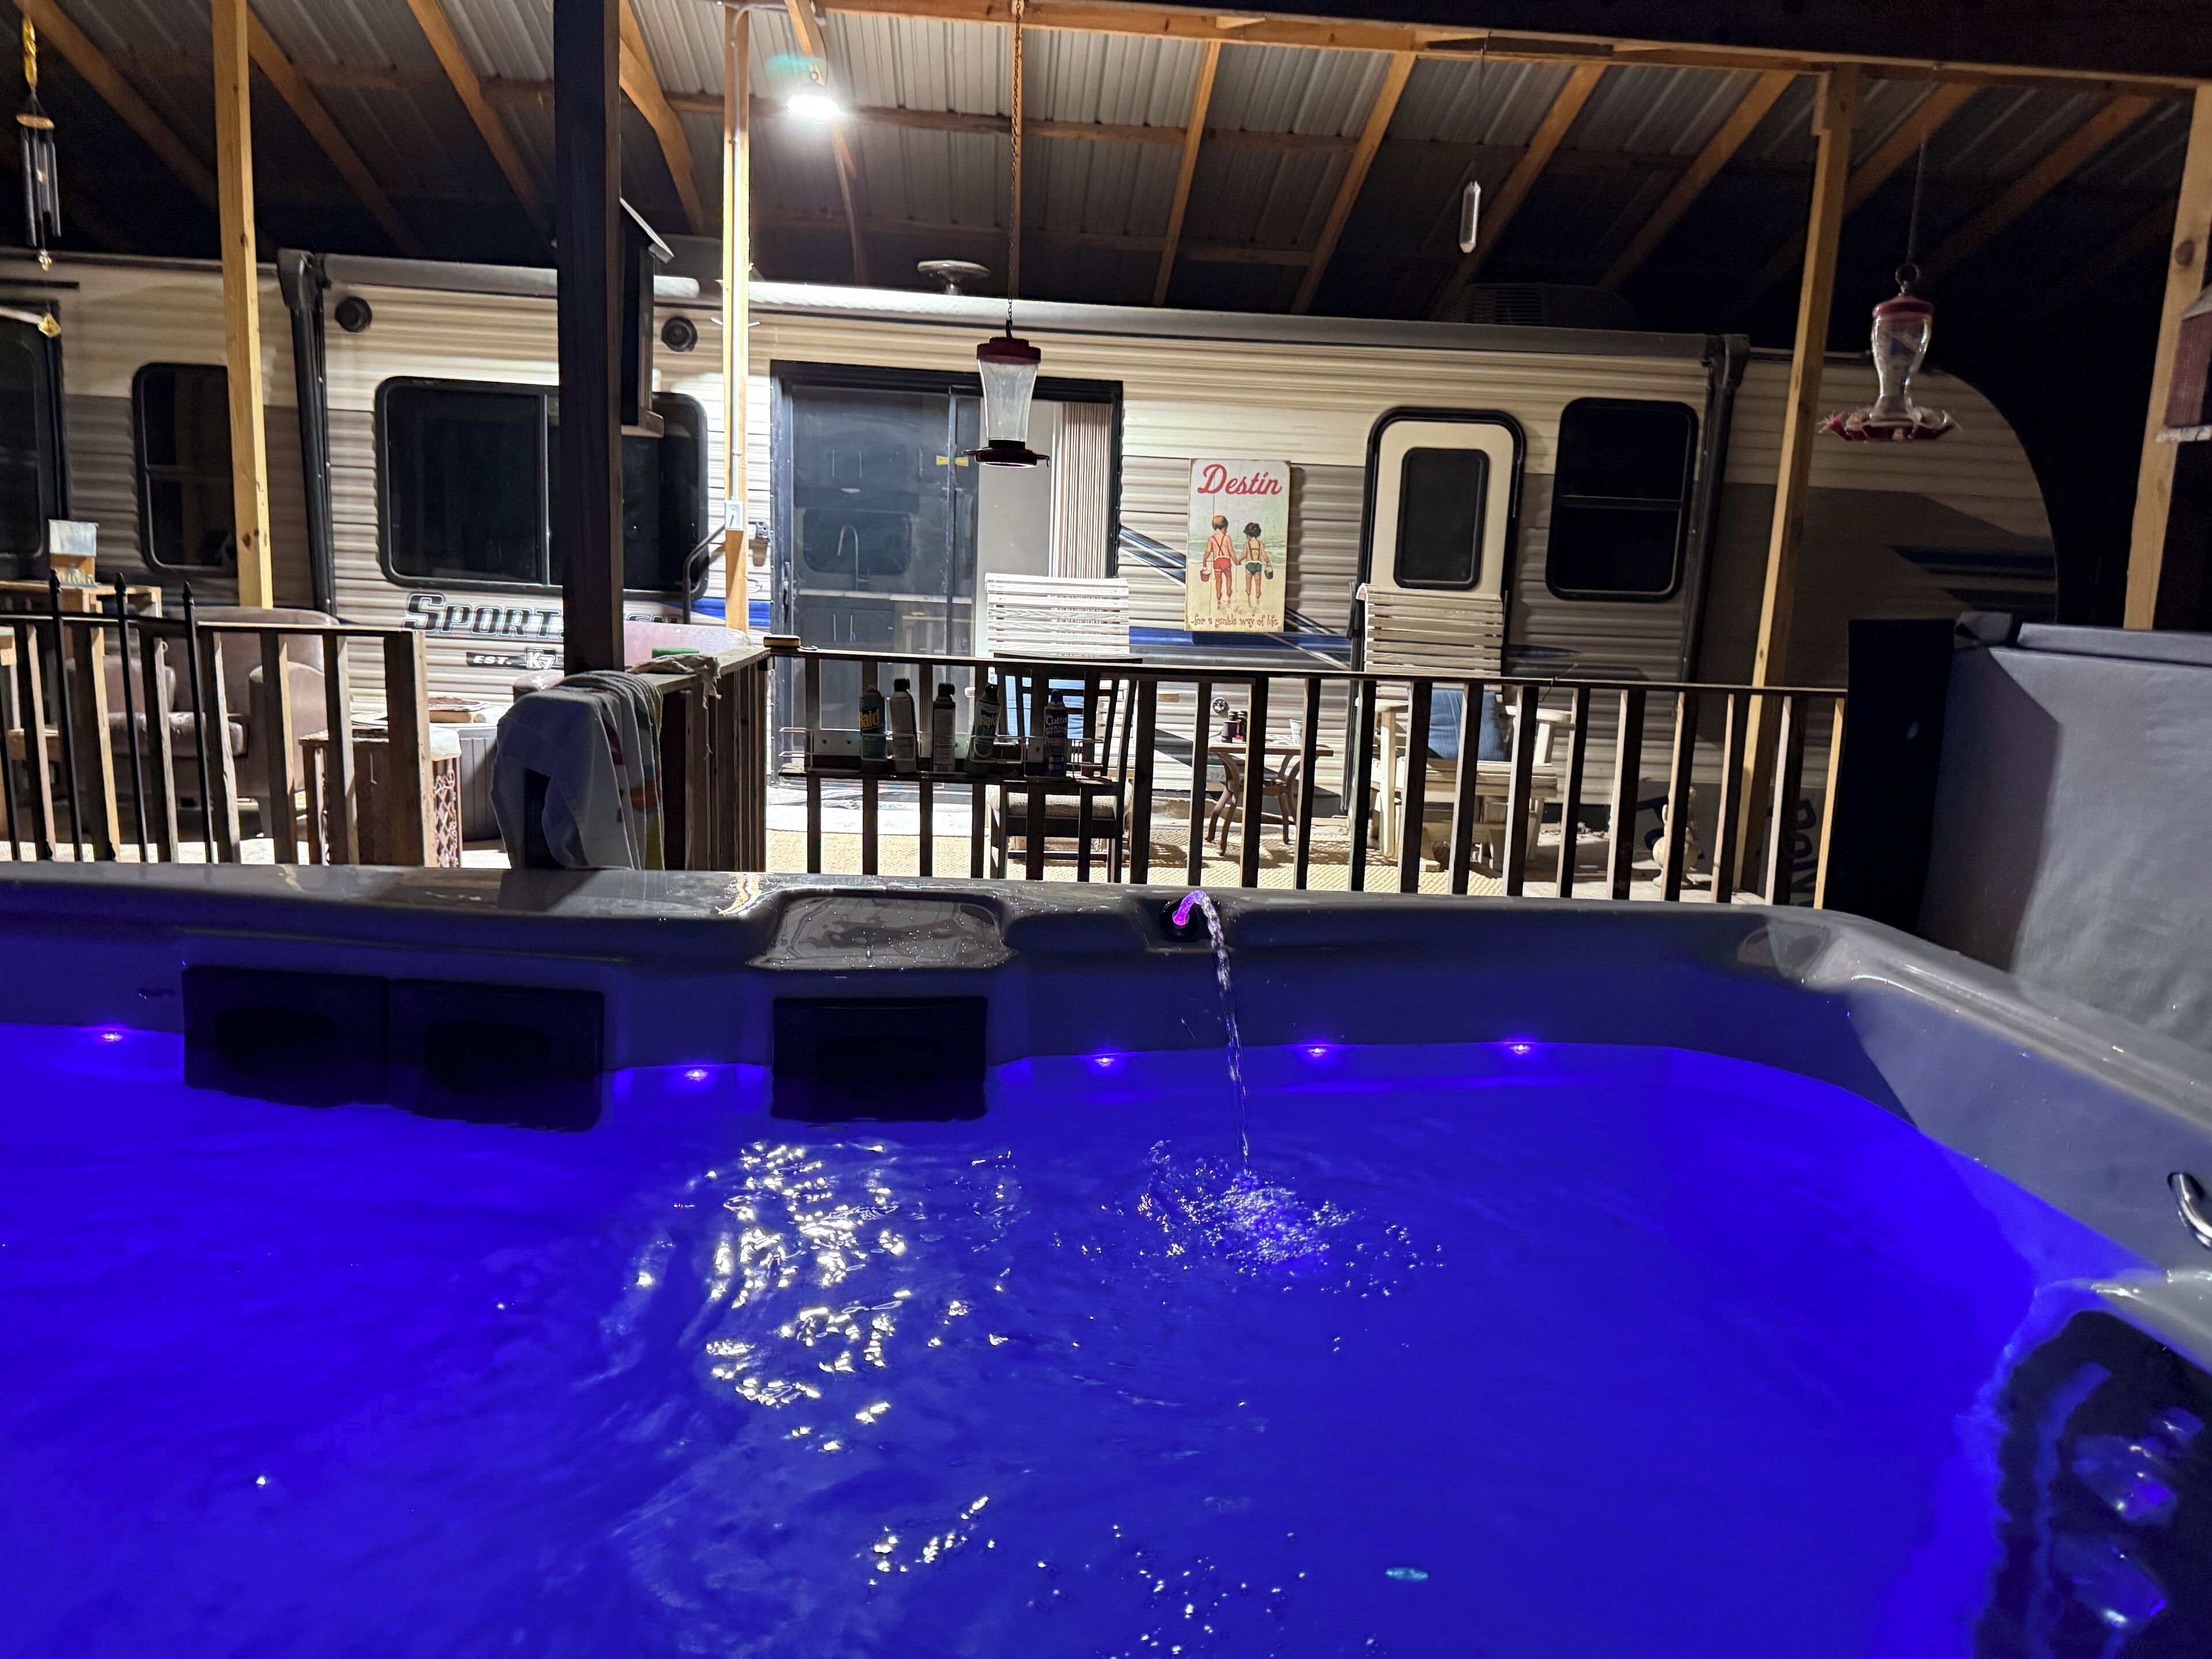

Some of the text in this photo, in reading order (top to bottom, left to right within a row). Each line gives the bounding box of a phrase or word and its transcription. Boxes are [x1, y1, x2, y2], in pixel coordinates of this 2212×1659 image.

[1197, 464, 1282, 495] Destin
[1215, 613, 1237, 628] gentle
[1240, 618, 1255, 628] way
[1256, 614, 1266, 626] of
[473, 656, 512, 665] EST.
